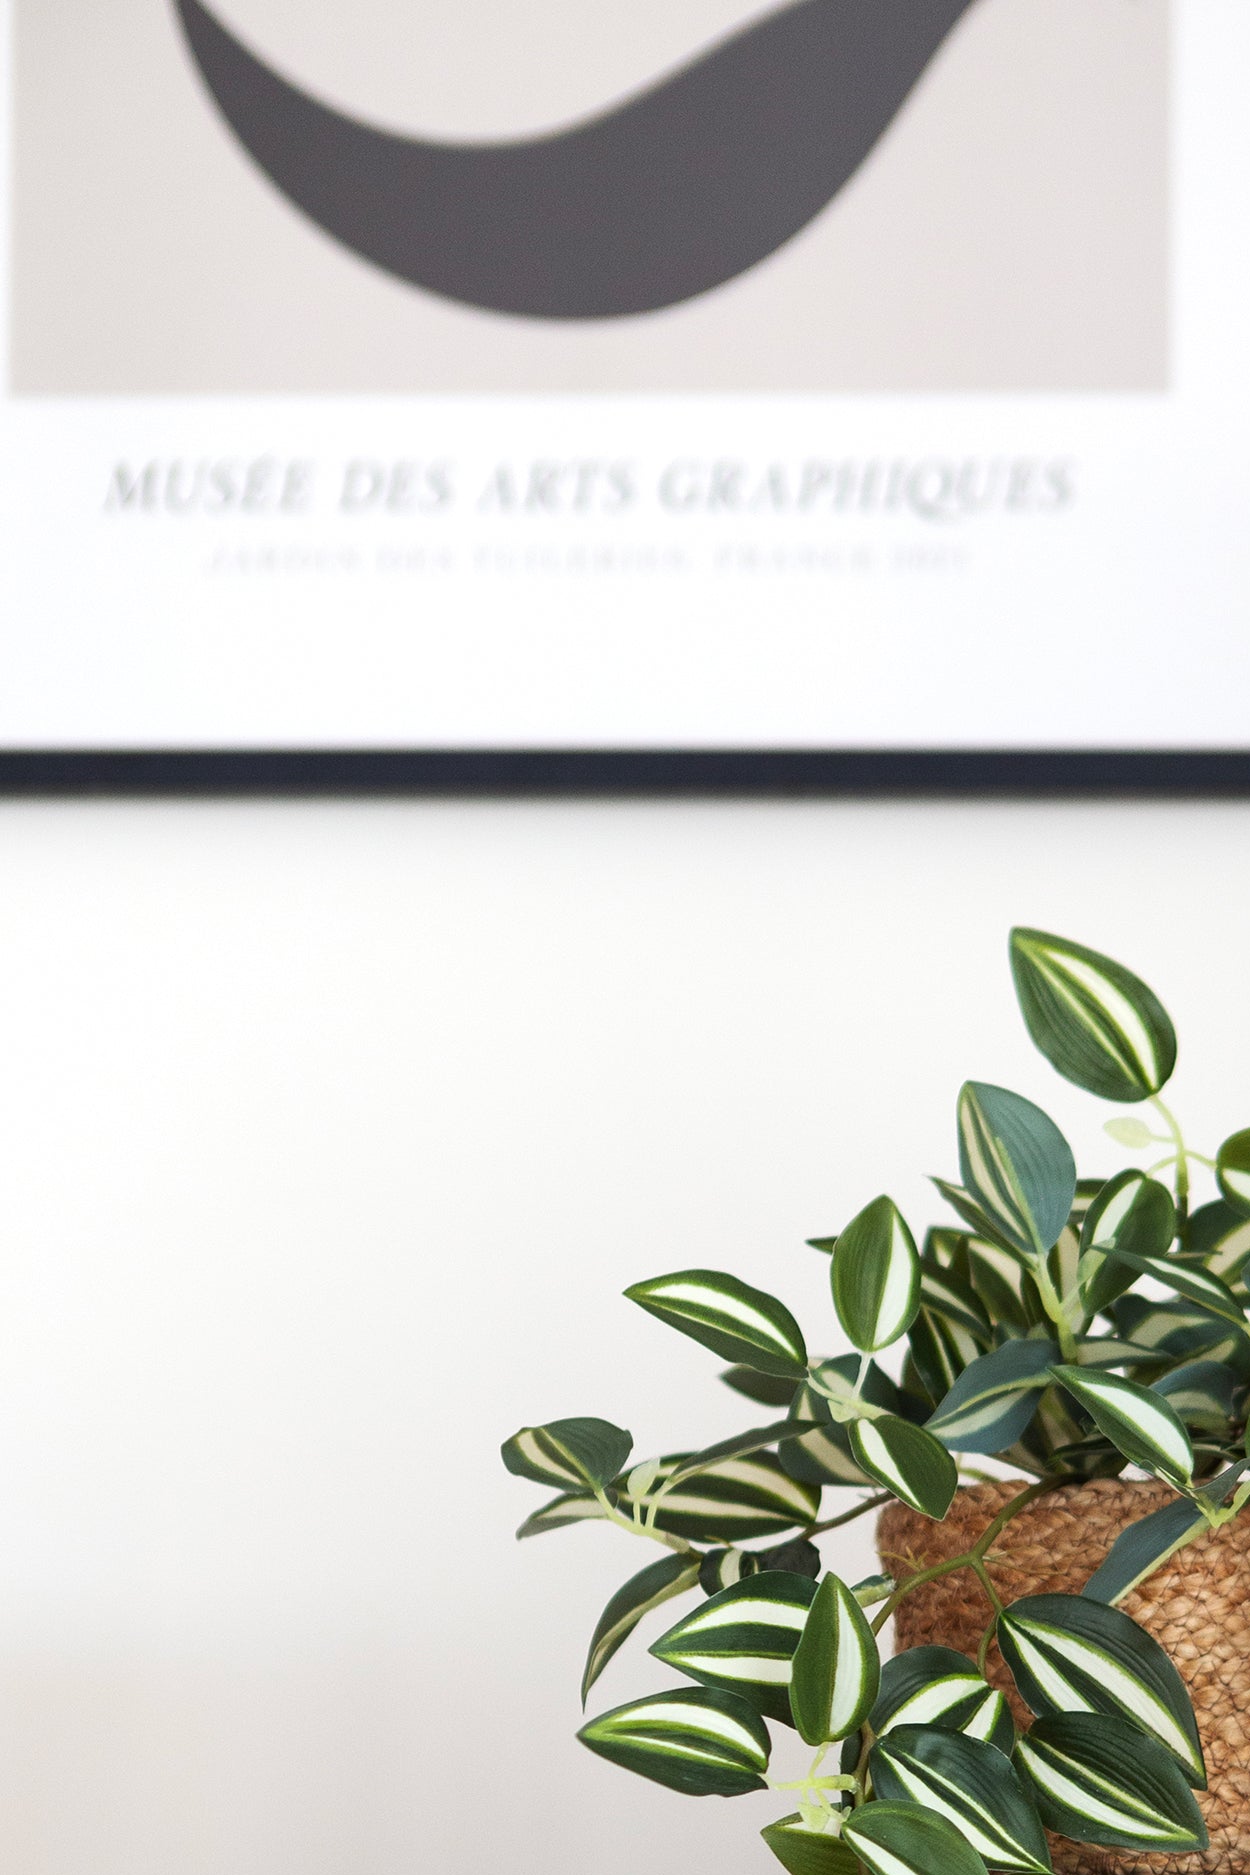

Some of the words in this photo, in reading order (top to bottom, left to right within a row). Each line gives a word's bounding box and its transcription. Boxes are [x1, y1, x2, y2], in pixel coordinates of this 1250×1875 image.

[103, 453, 311, 515] MUSÉE
[337, 458, 455, 515] DES
[477, 458, 637, 515] ARTS
[656, 457, 1077, 522] GRAPHIQUES
